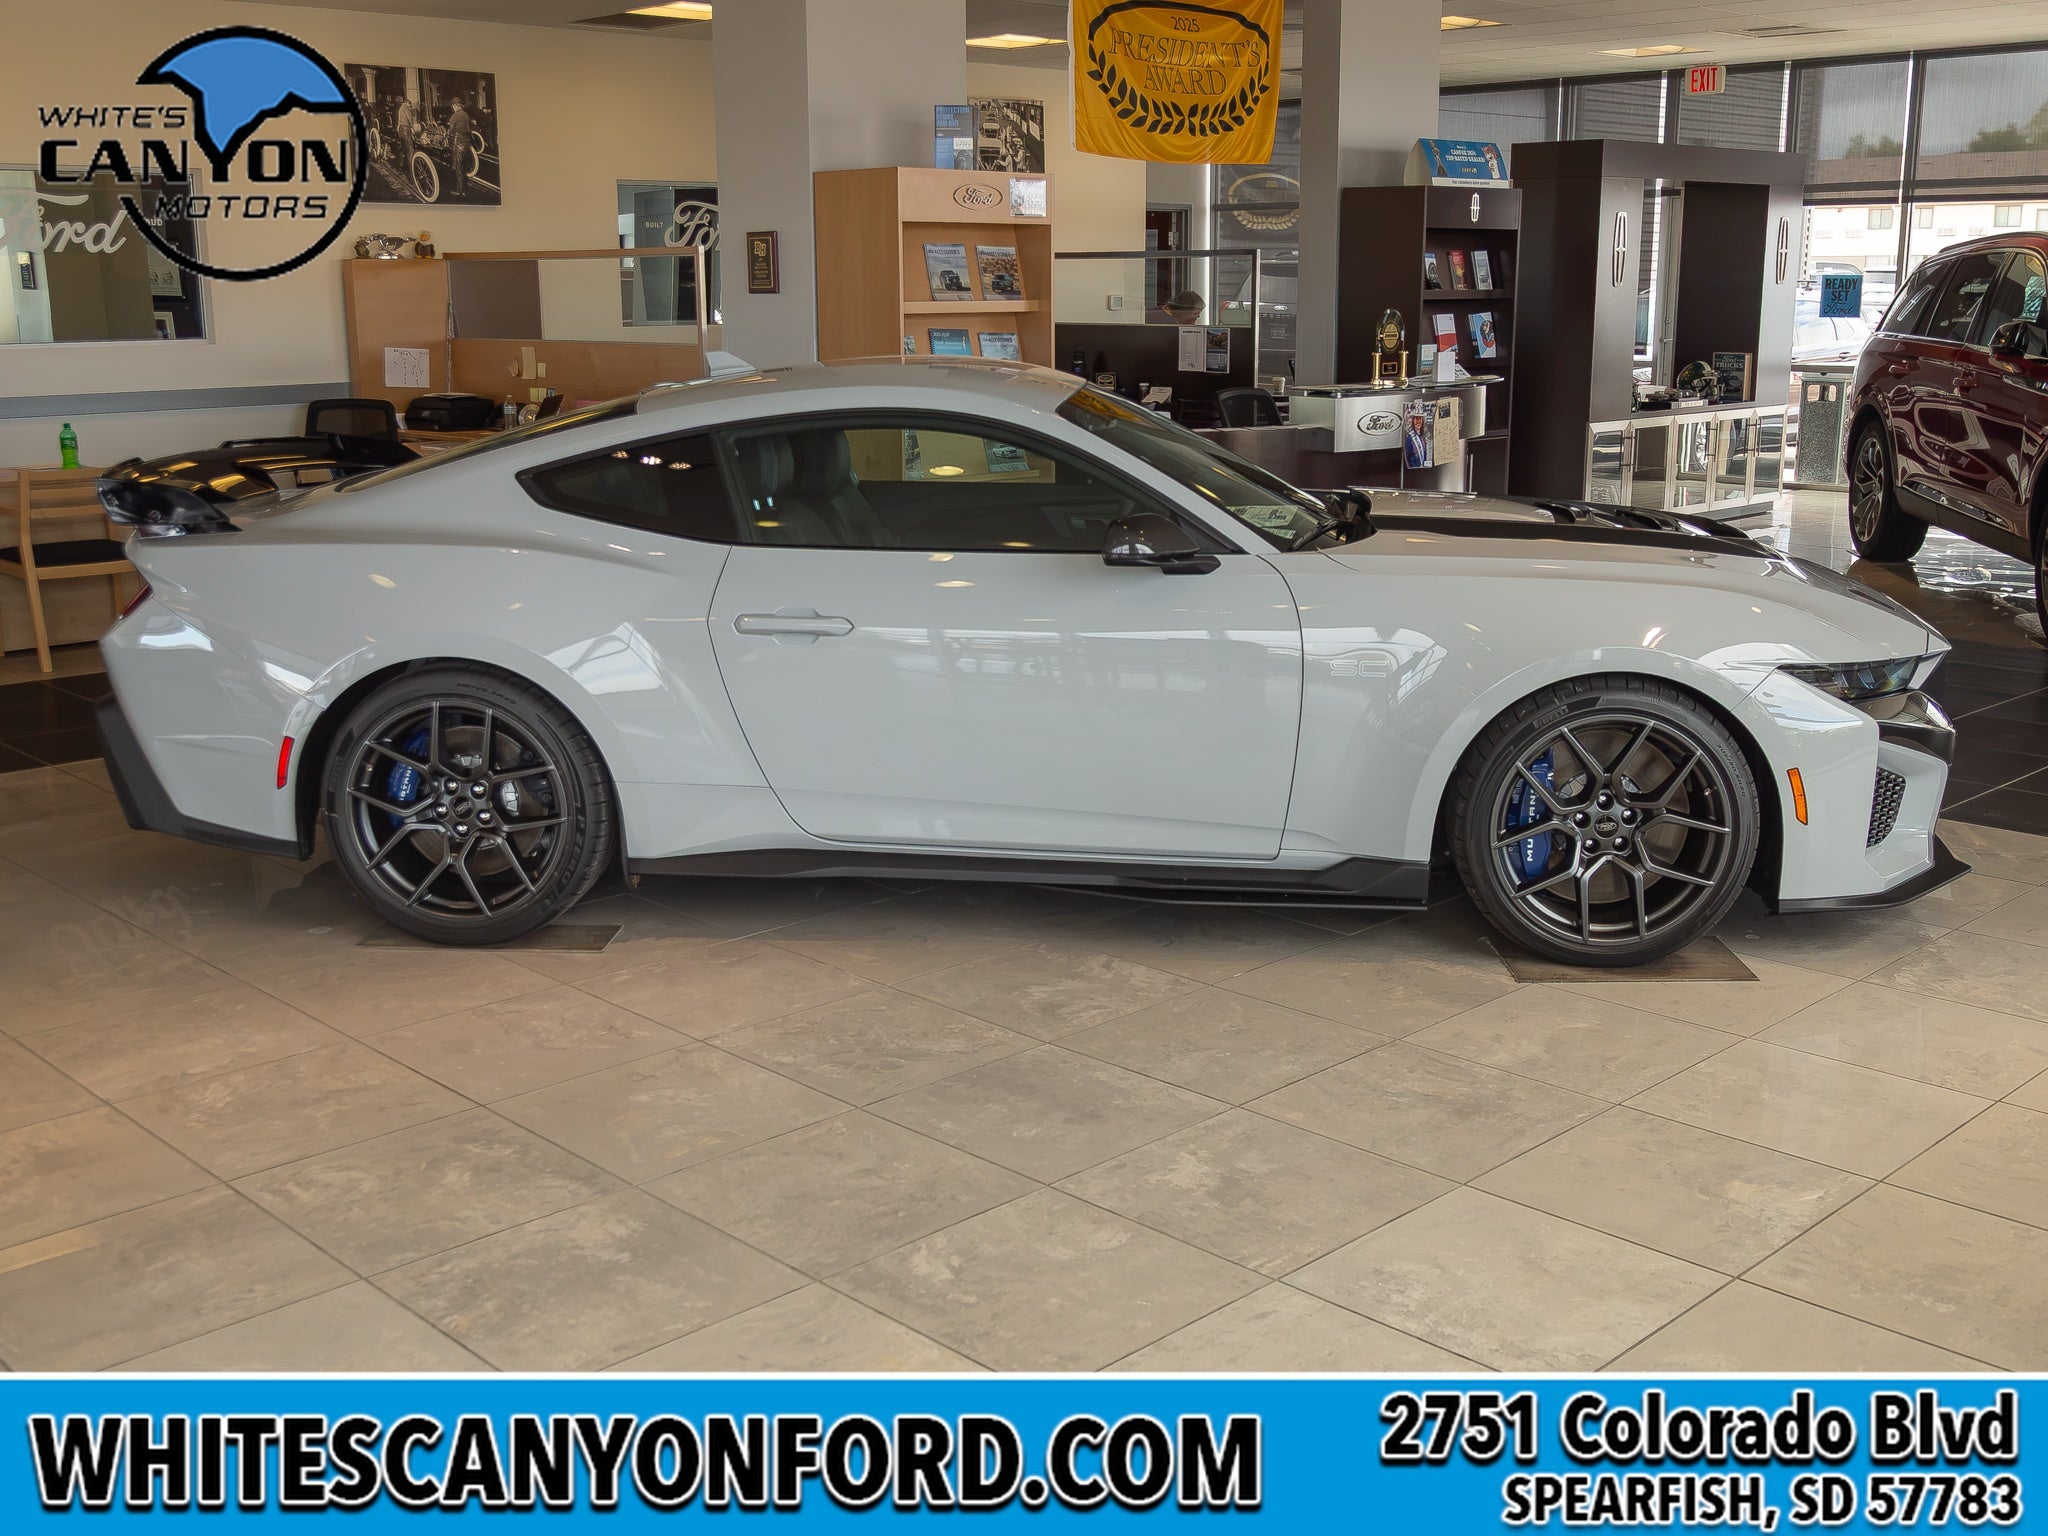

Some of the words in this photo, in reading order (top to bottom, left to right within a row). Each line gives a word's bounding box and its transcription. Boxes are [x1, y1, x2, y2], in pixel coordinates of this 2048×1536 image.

[1170, 16, 1200, 33] 2025
[1108, 25, 1261, 68] PRESIDENT'S
[1144, 65, 1227, 96] AWARD
[1690, 67, 1718, 93] EXIT
[963, 187, 993, 205] Ford
[645, 221, 663, 229] BUILT
[664, 201, 719, 250] Fo
[1825, 278, 1859, 290] READY
[1831, 290, 1850, 302] SET
[1823, 301, 1856, 315] Ford
[1715, 361, 1744, 369] TRUCKS
[1366, 414, 1395, 431] Ford
